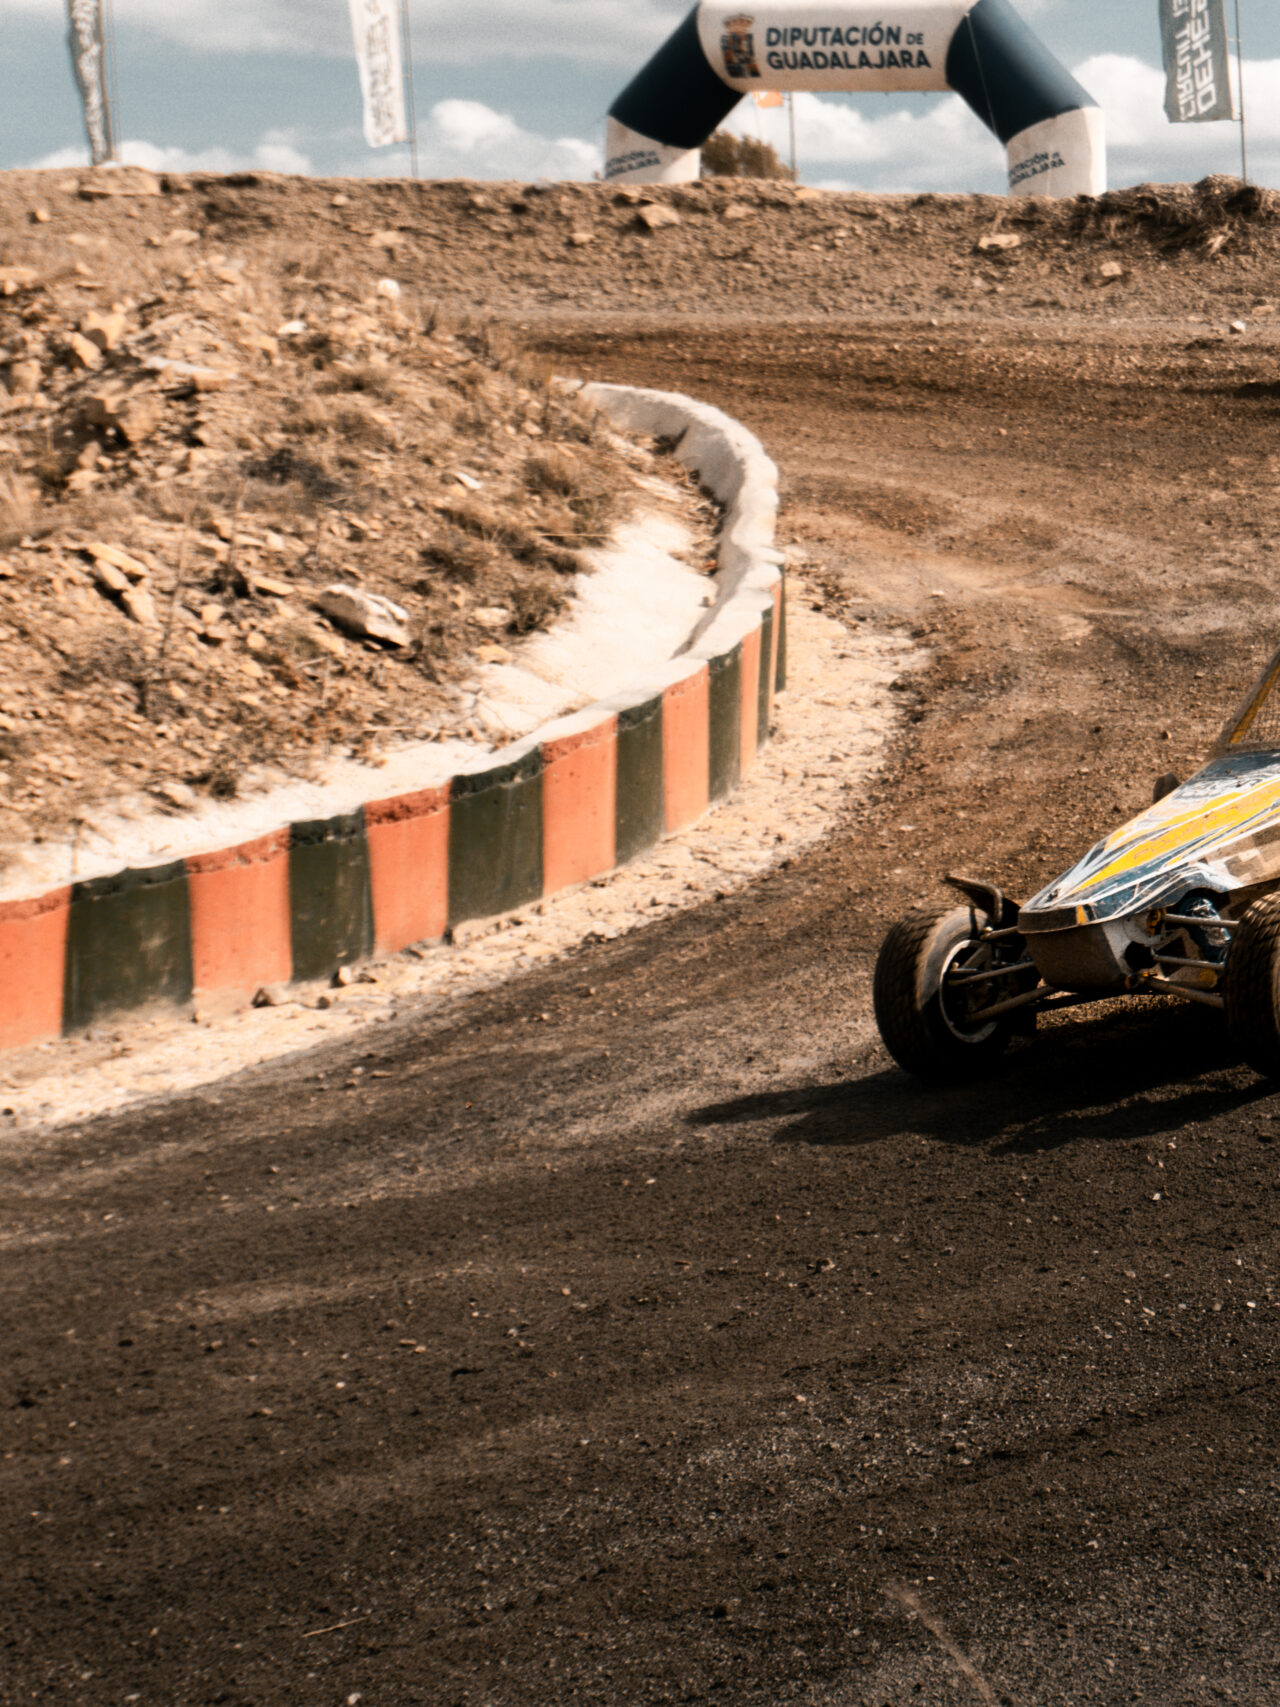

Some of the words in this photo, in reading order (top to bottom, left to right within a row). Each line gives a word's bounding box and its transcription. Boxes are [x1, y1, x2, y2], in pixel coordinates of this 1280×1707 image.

[766, 21, 901, 47] DIPUTACIÓN
[906, 33, 924, 45] DE
[767, 50, 931, 70] GUADALAJARA
